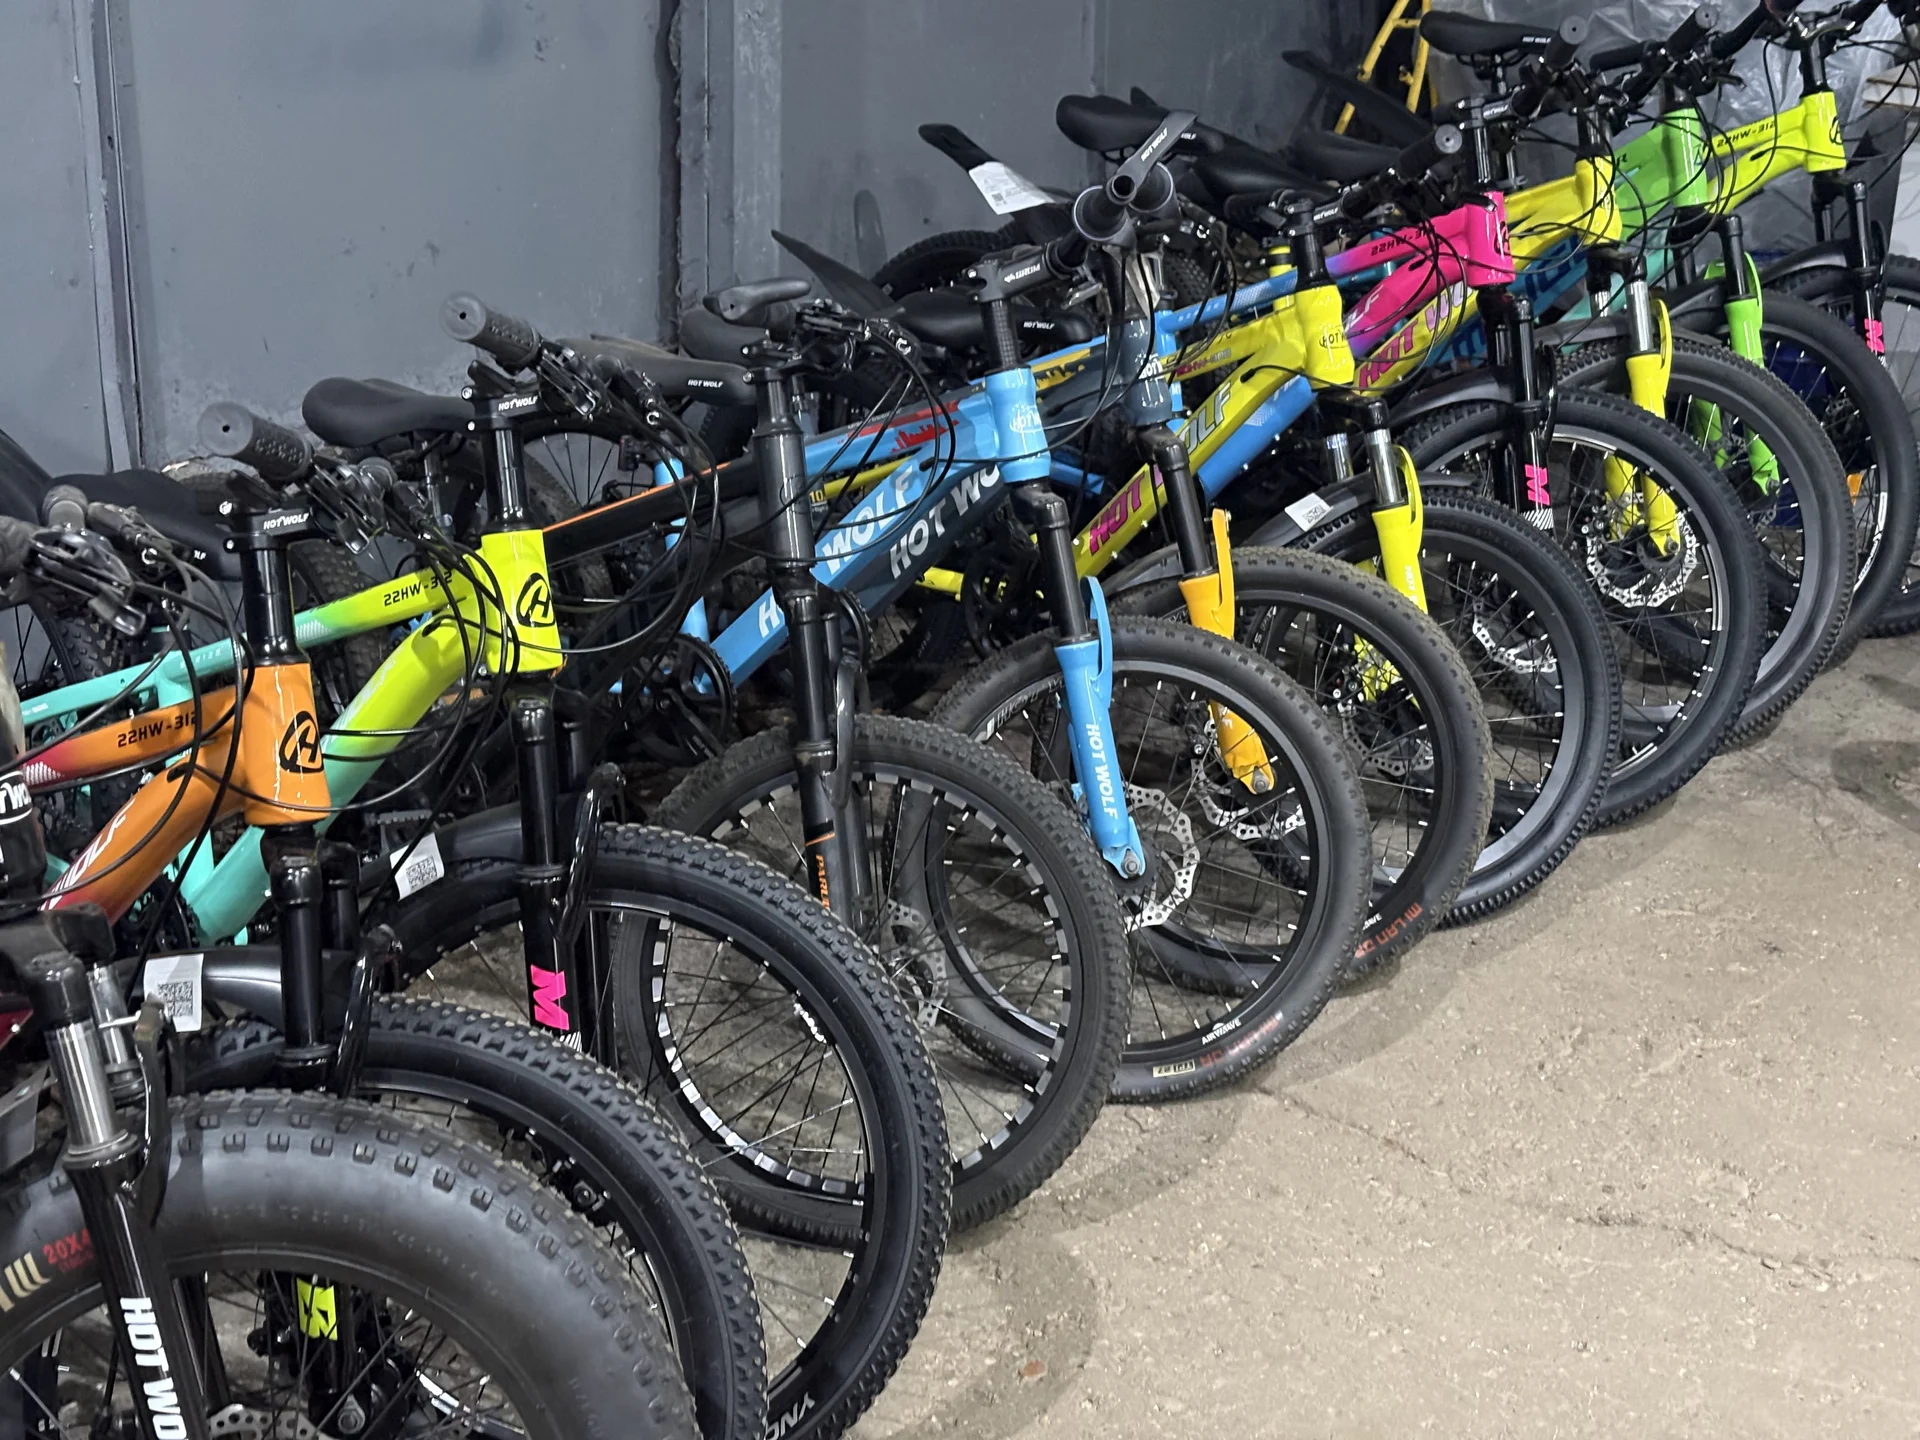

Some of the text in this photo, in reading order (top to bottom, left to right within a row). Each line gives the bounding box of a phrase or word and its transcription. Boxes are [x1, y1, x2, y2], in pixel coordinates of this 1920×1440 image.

[821, 464, 914, 575] WOLF
[889, 463, 1000, 579] HOT WO
[1089, 472, 1146, 554] HOT
[1085, 723, 1119, 820] HOT WOLF
[120, 1297, 188, 1440] HOT WO
